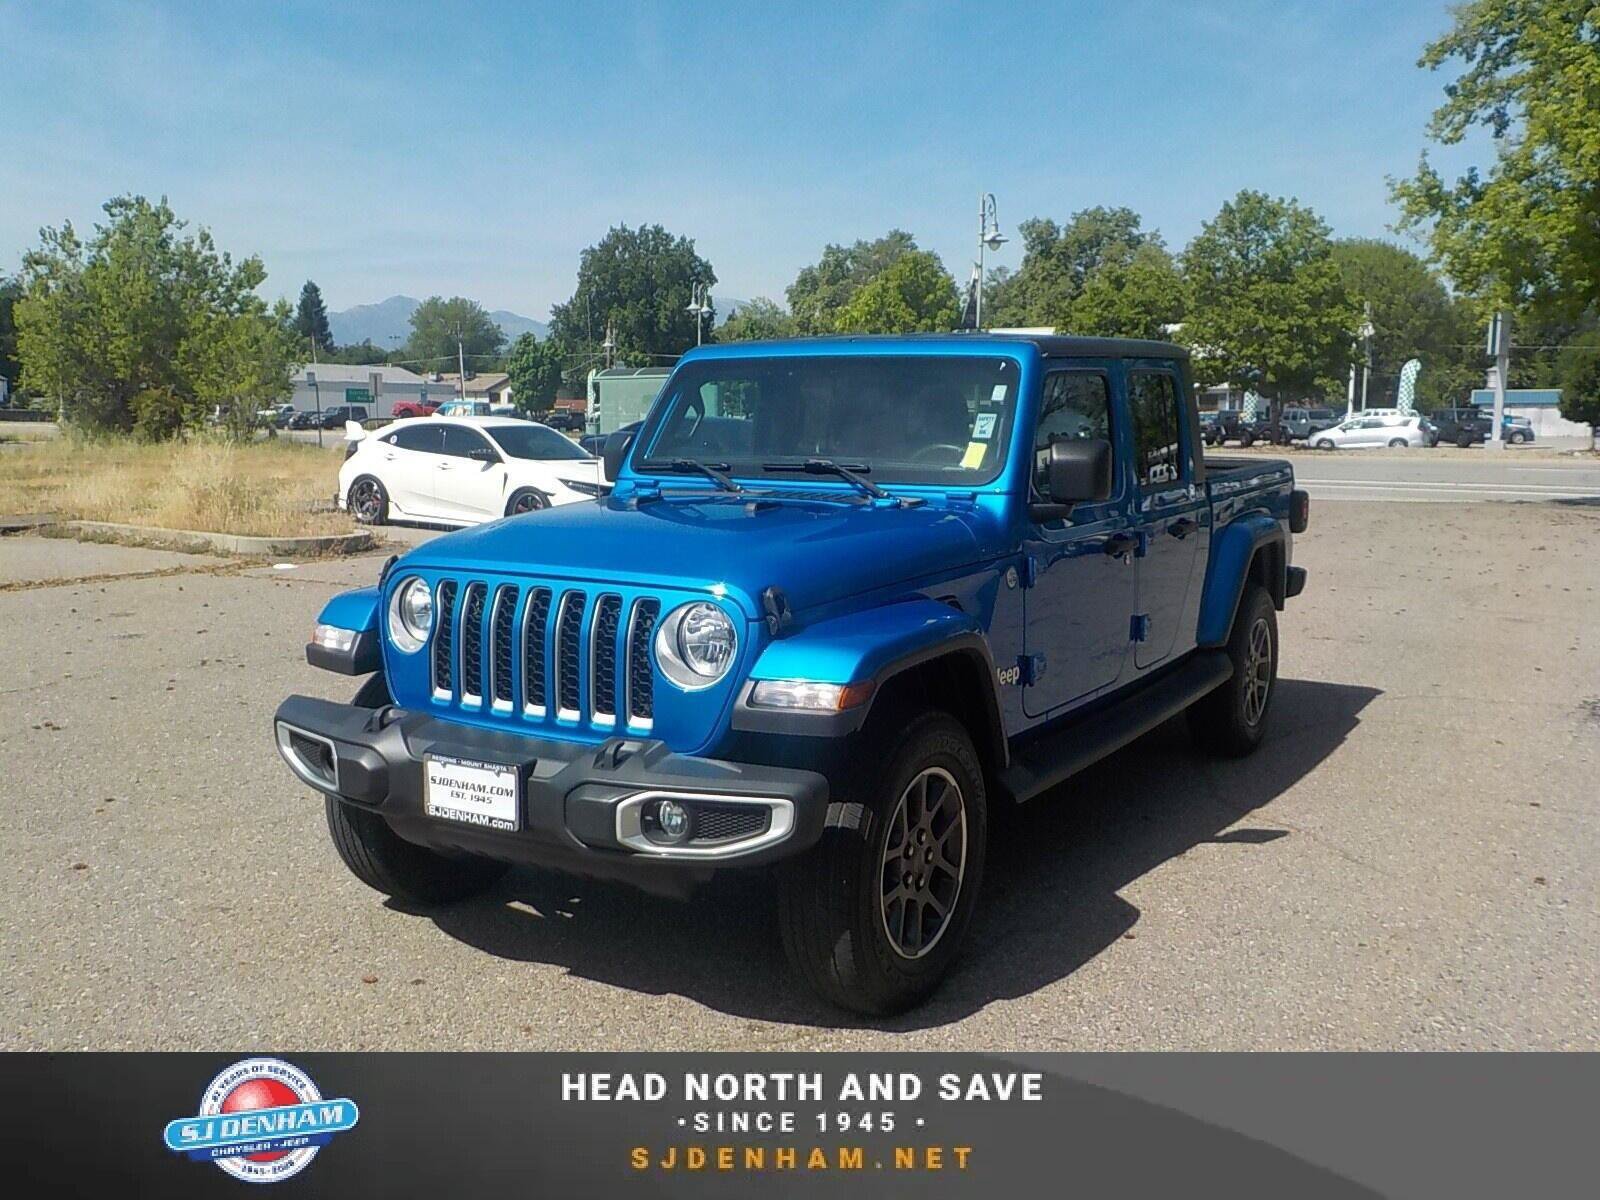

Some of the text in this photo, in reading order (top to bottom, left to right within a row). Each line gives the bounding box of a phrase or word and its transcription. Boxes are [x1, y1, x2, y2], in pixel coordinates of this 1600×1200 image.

[461, 759, 483, 768] MOUNT
[484, 763, 507, 772] SHASTA
[430, 775, 514, 798] SJDENHAM.COM
[450, 790, 493, 805] EST. 1945
[428, 804, 514, 831] SJDENHAM.com
